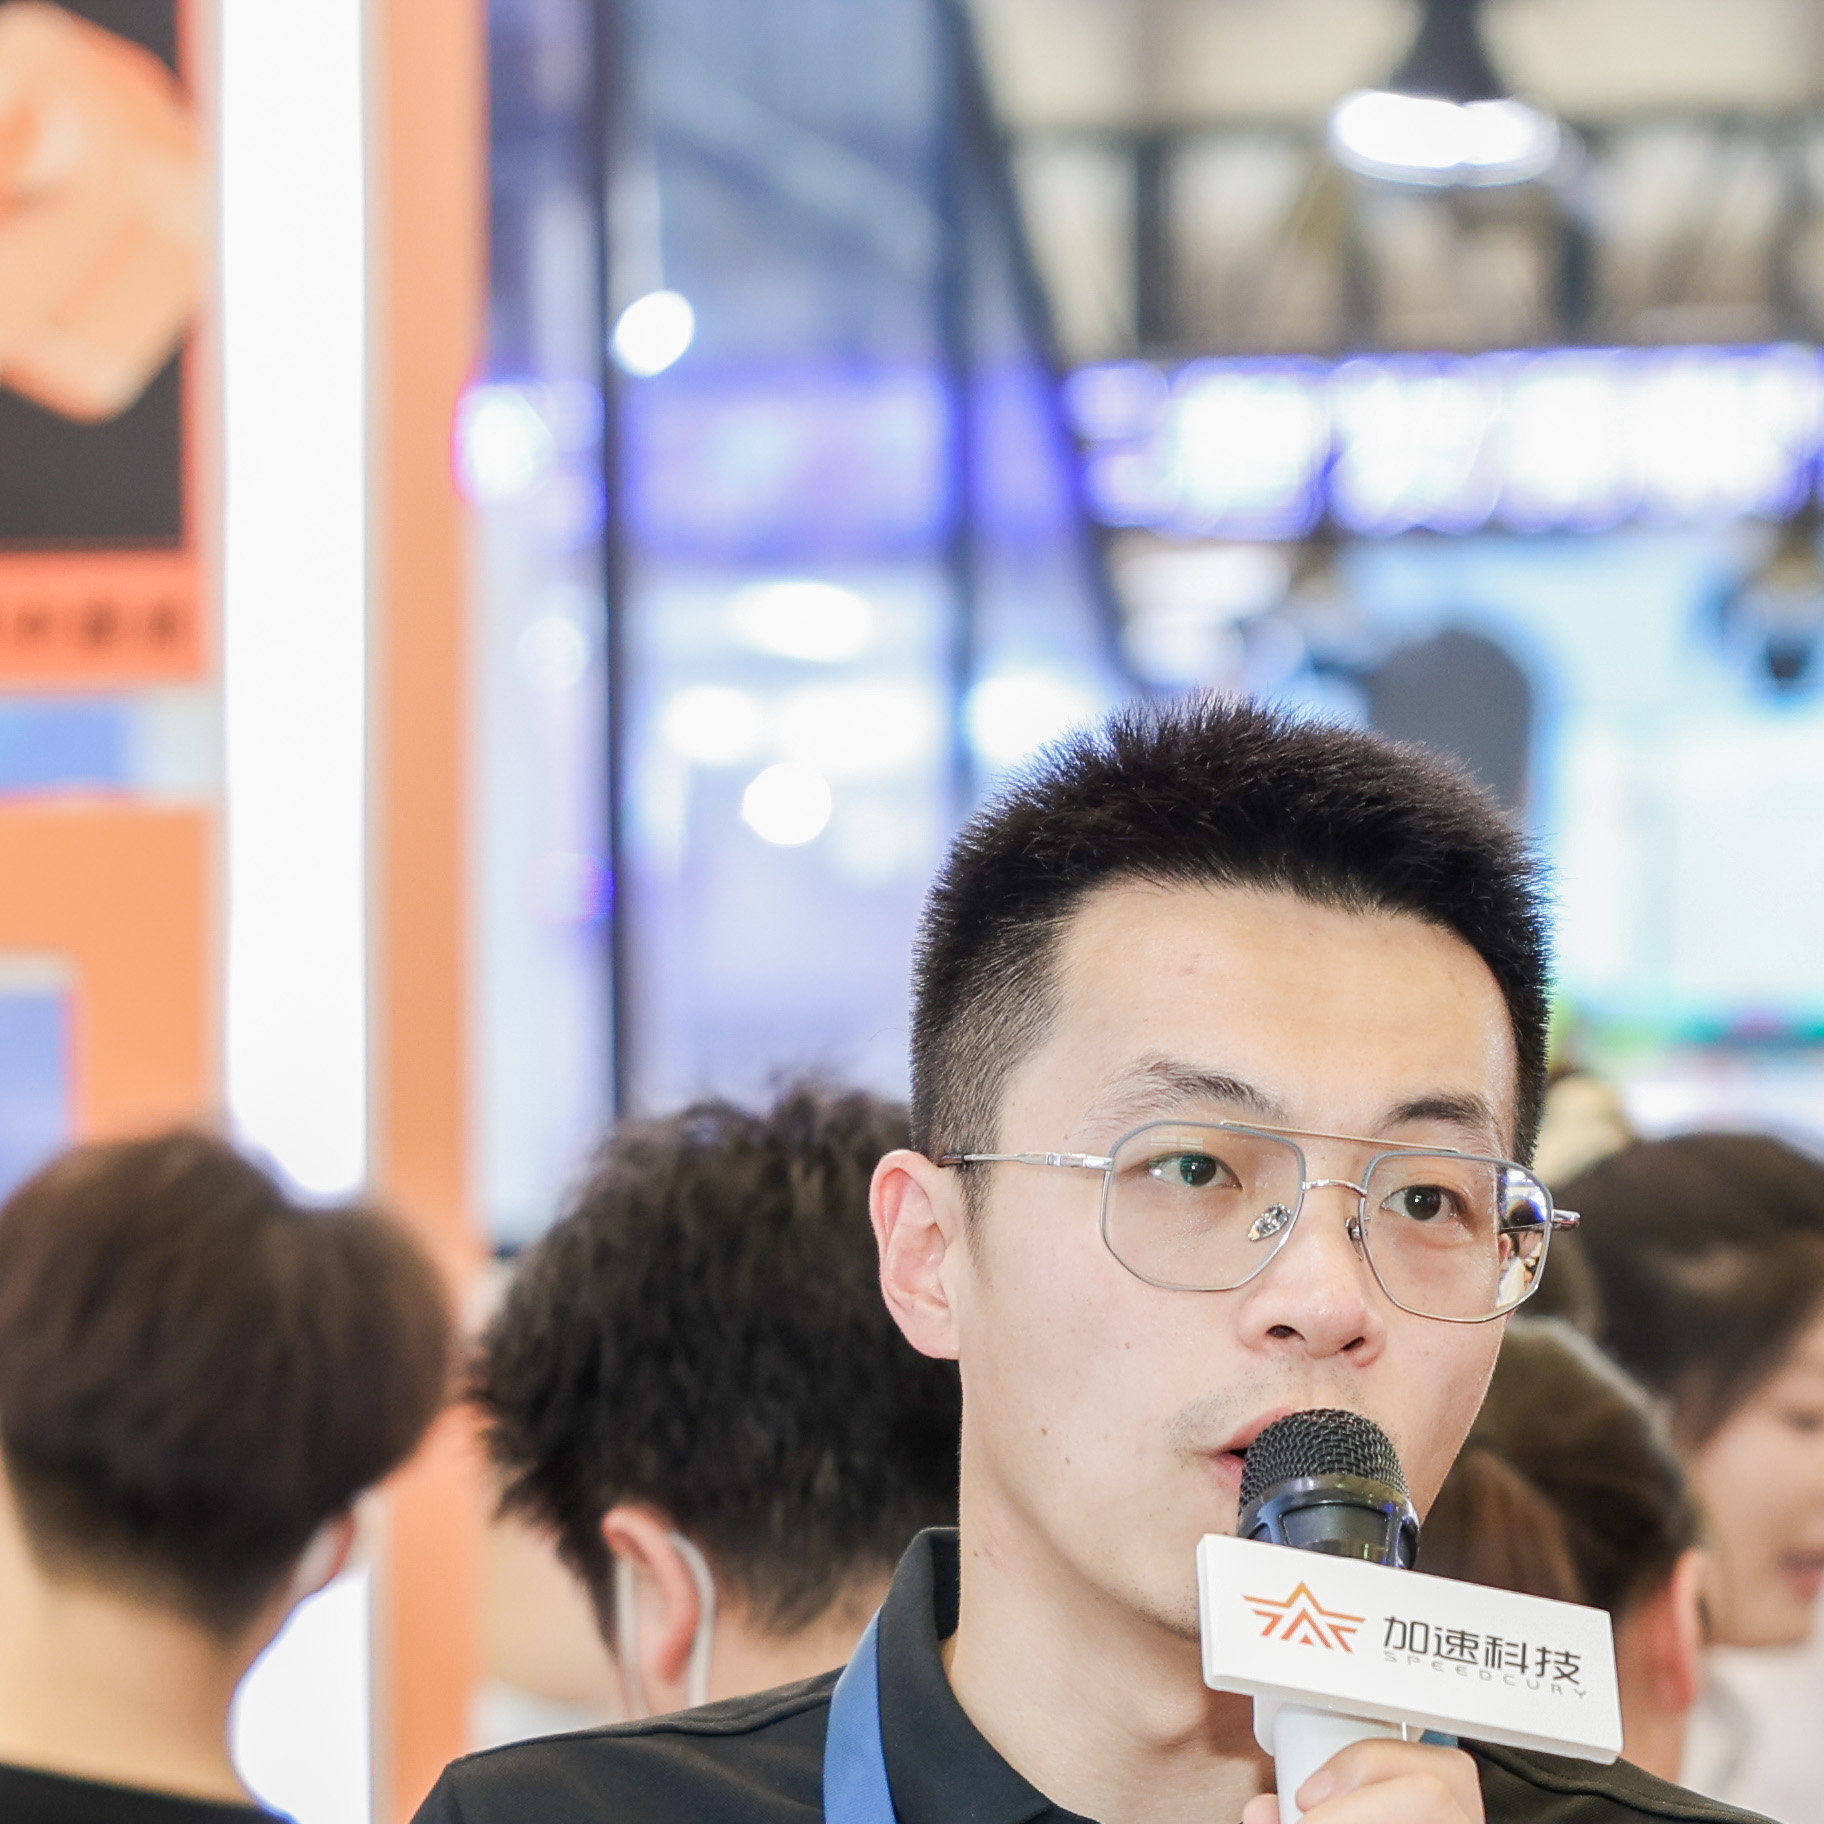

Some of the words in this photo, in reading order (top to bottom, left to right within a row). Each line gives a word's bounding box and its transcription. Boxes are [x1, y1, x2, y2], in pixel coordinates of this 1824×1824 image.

[1382, 1614, 1583, 1687] 加速科技
[1383, 1650, 1588, 1700] SPEEDCURY
